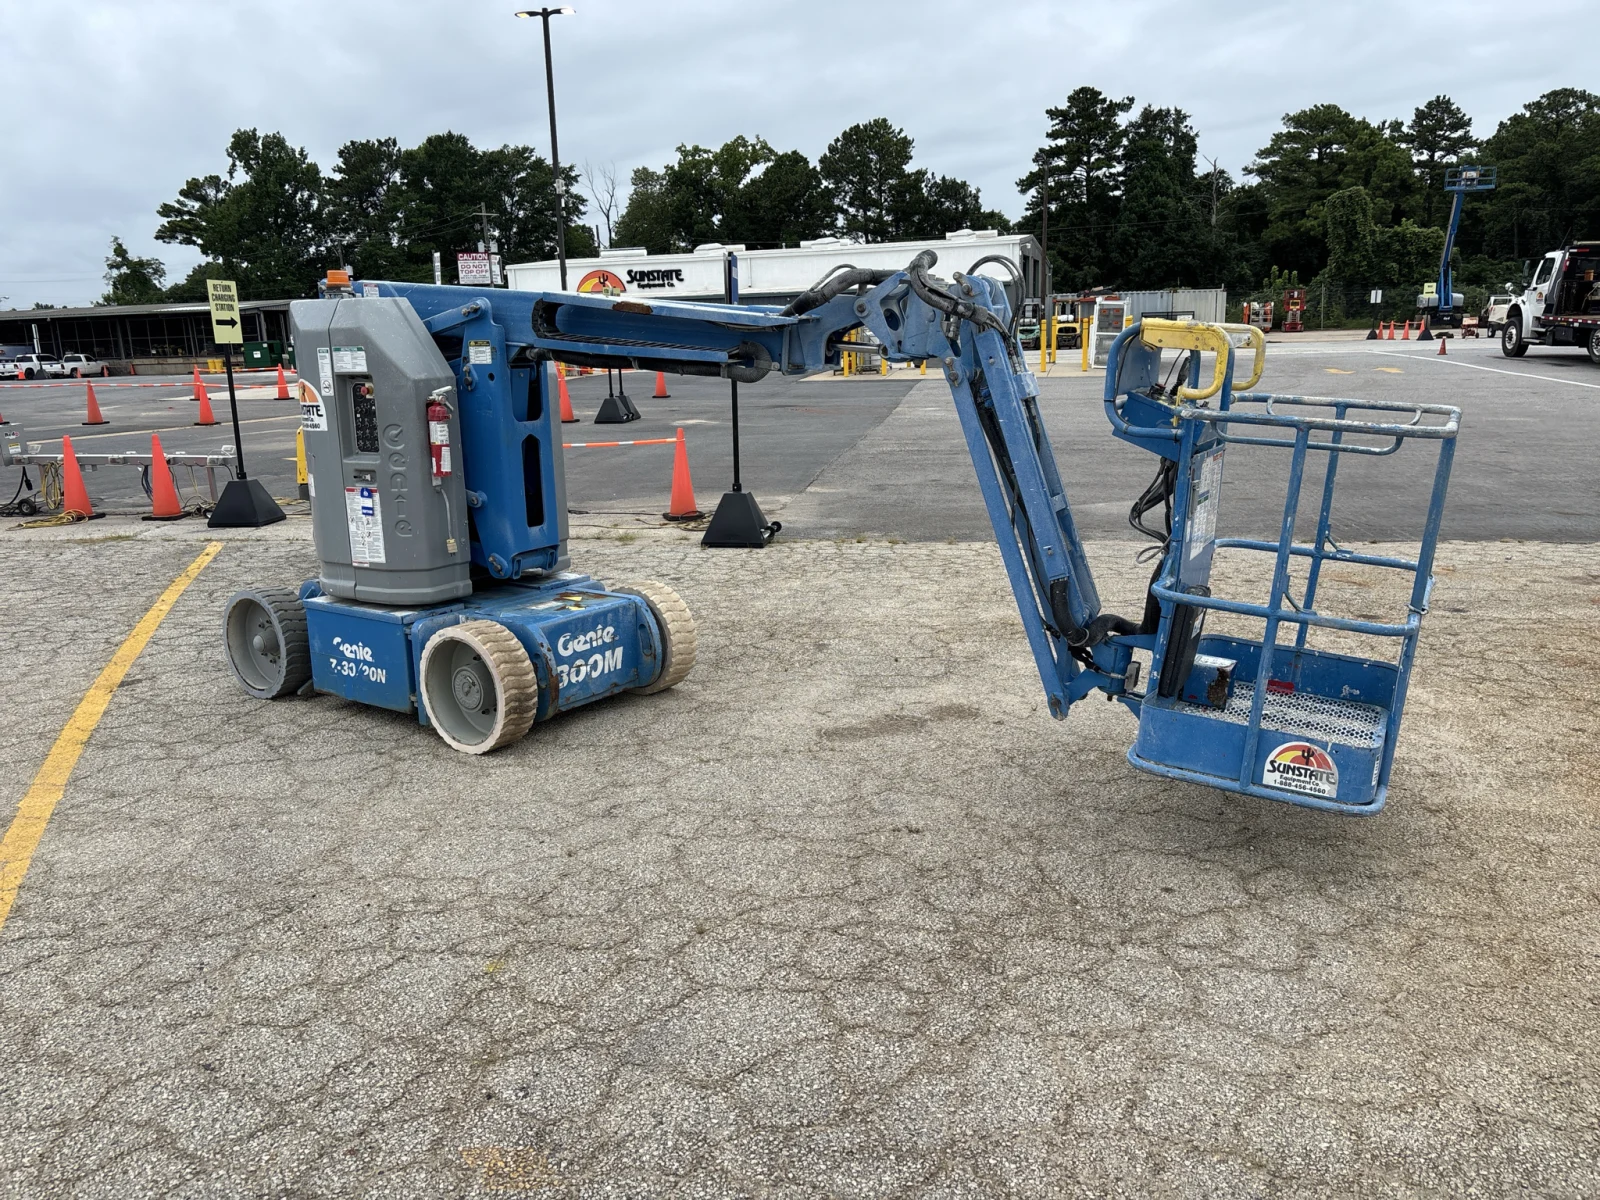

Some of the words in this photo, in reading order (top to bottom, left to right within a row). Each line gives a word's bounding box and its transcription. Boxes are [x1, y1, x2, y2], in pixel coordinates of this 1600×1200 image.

[626, 269, 684, 284] SUNSTATE
[213, 283, 231, 292] RETURN
[212, 293, 235, 302] CHARGING
[215, 303, 234, 311] STATION
[383, 423, 413, 537] Genie
[557, 624, 615, 657] Genie
[557, 646, 624, 690] BOOM
[1267, 760, 1336, 785] SUNSTATE
[1280, 774, 1311, 785] Equipment
[1274, 779, 1326, 795] 1-888-456-4560
